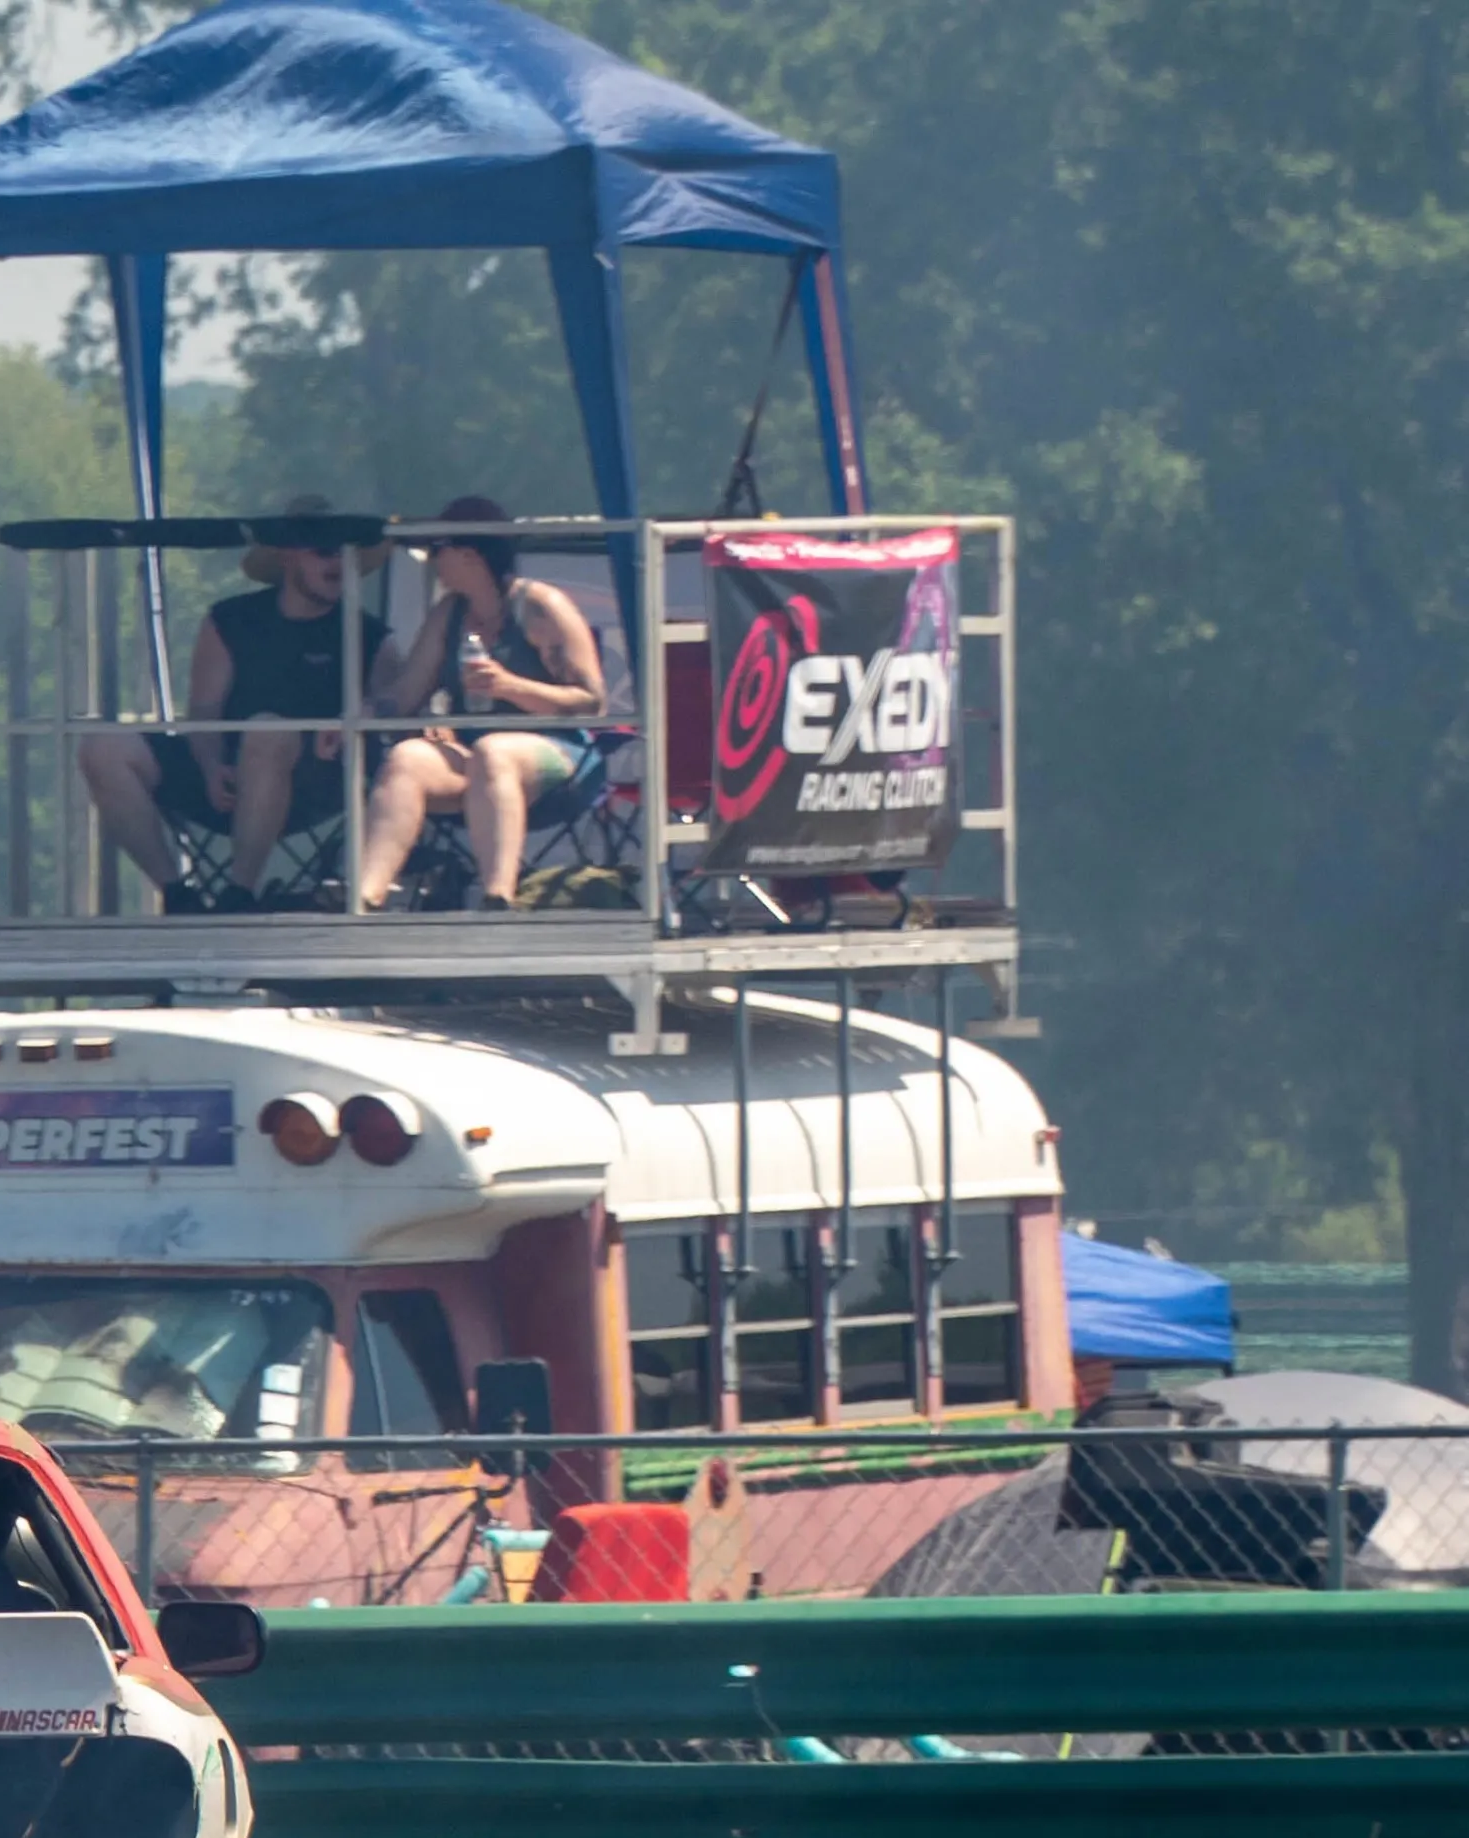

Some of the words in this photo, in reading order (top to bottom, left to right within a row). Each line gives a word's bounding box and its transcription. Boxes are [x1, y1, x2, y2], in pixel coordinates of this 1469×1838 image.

[796, 772, 883, 812] RACING
[883, 766, 947, 809] CLUTCH
[6, 1709, 96, 1732] NASCAR
